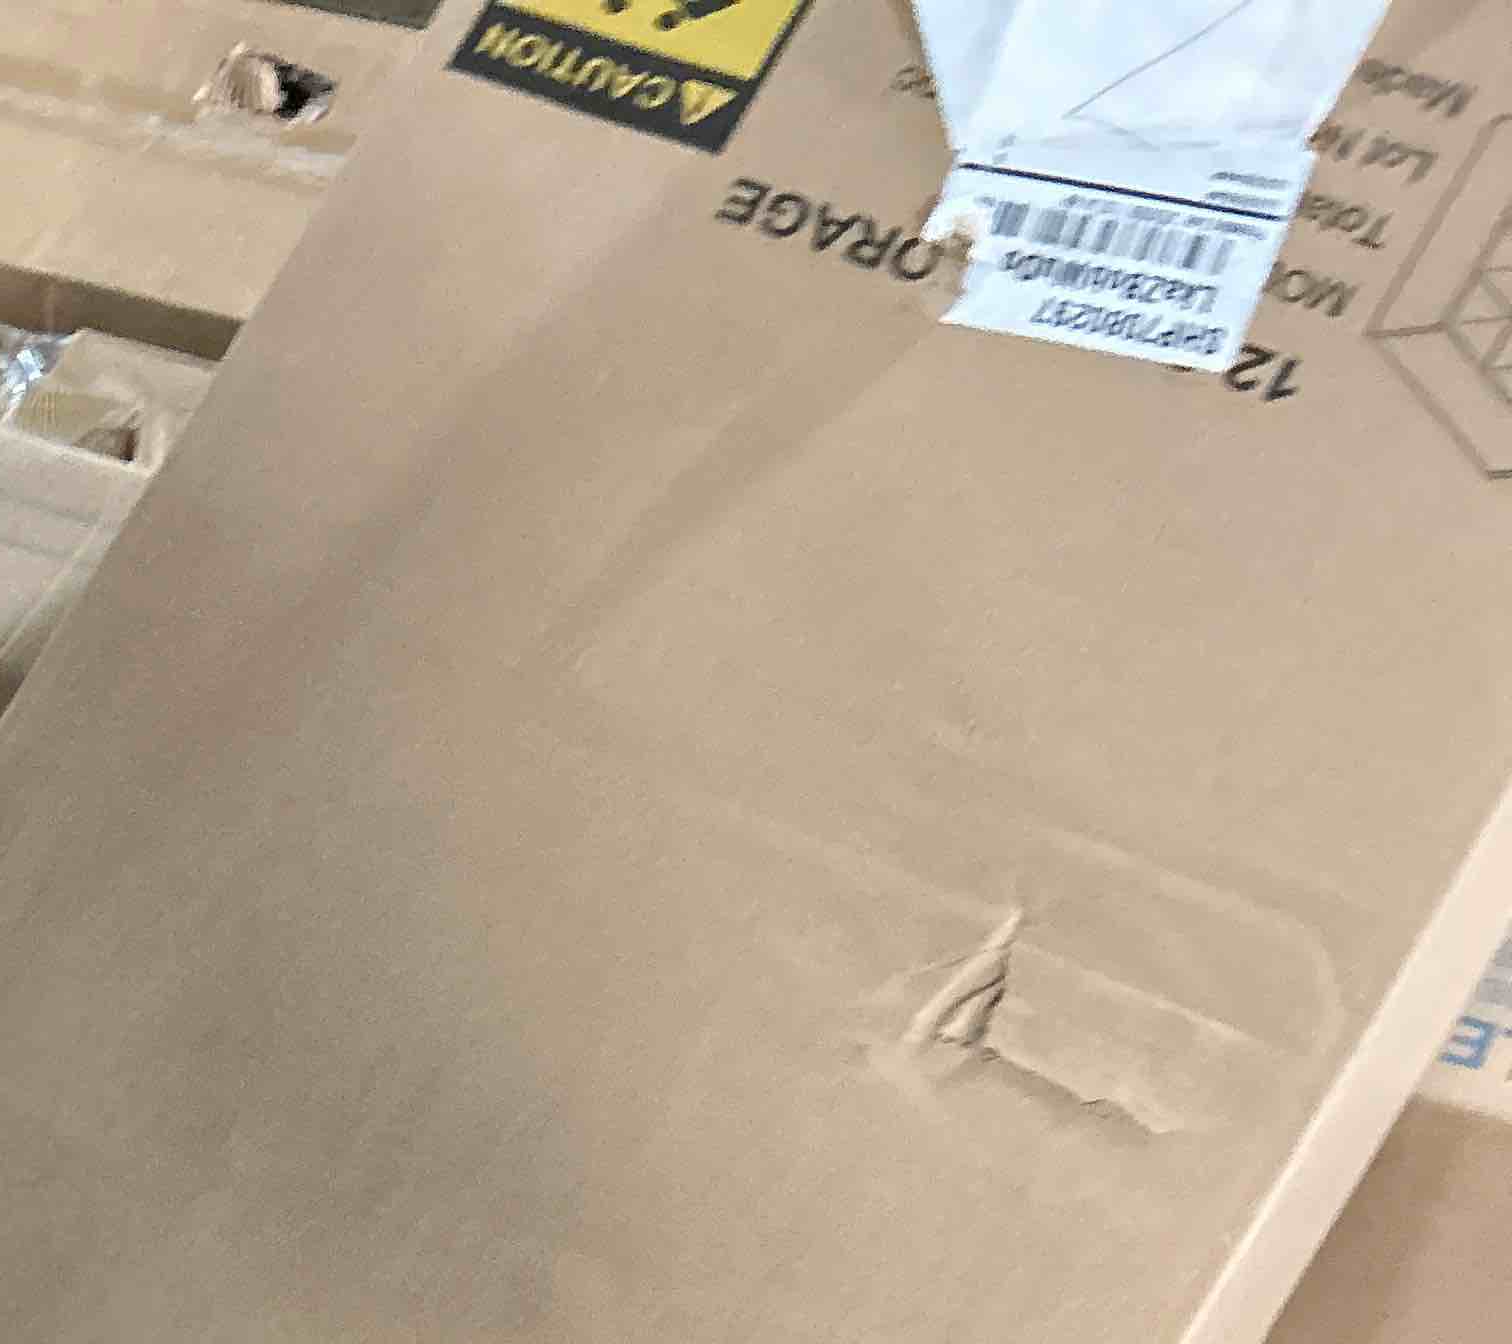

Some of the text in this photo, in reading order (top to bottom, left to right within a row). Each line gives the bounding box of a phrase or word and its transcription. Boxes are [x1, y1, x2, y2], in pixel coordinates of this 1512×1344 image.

[472, 20, 680, 112] CAUTION
[714, 176, 952, 281] ORAGE
[1298, 193, 1392, 250] Tota
[1223, 343, 1303, 402] 12
